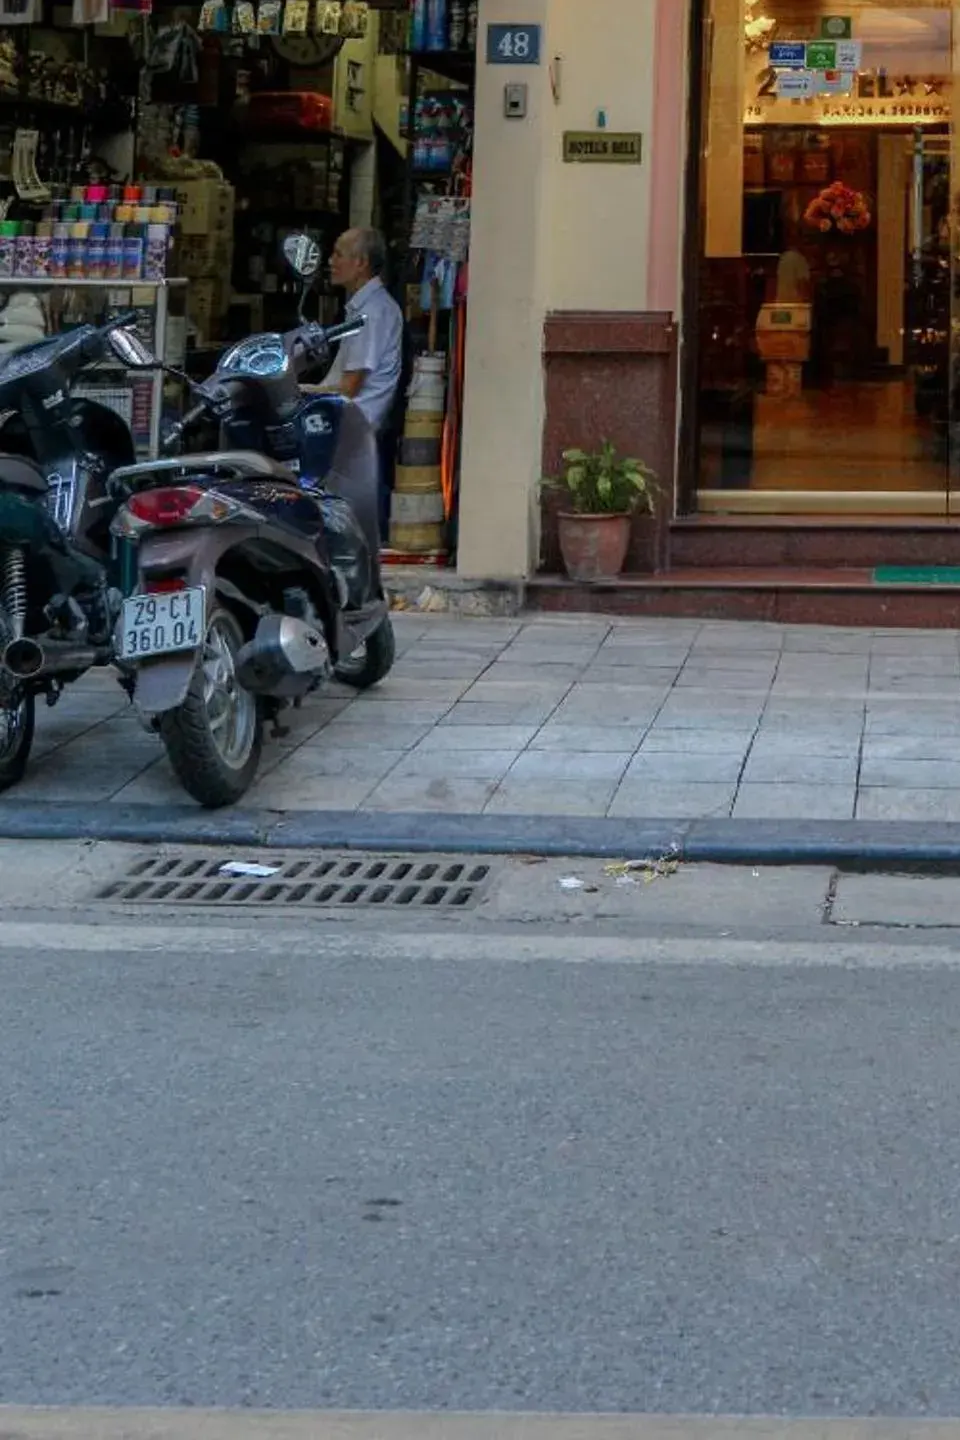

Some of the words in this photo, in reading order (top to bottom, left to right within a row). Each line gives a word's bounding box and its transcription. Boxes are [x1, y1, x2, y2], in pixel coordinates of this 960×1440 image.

[498, 31, 530, 58] 48
[133, 593, 191, 627] 29-C1
[127, 619, 198, 655] 360.04
